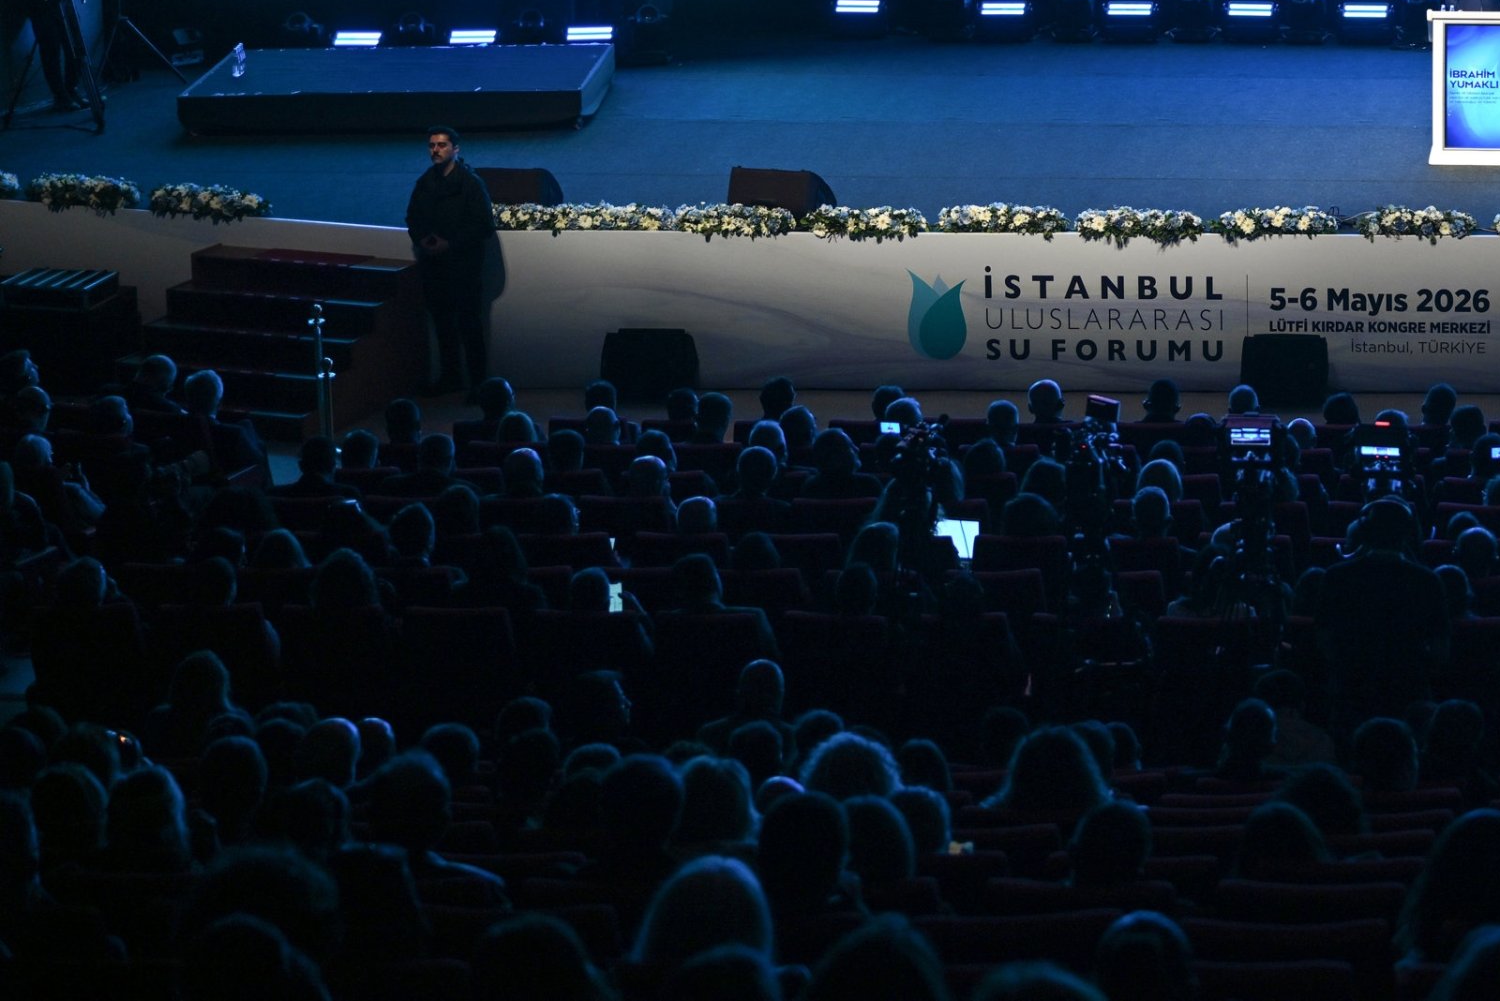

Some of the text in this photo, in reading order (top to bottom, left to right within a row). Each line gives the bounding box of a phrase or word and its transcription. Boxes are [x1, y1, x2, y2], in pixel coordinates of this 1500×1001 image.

[1449, 67, 1496, 79] İBRAHİM
[1449, 80, 1499, 89] YUMAKLI
[984, 266, 1223, 300] İSTANBUL
[1269, 287, 1490, 316] 5-6 Mayıs 2026
[985, 307, 1224, 331] ULUSLARARASI
[1269, 318, 1491, 335] LÜTFİ KIRDAR KONGRE MERKEZİ
[986, 338, 1223, 362] SU FORUMU
[1350, 337, 1486, 355] İstanbul, TÜRKİYE
